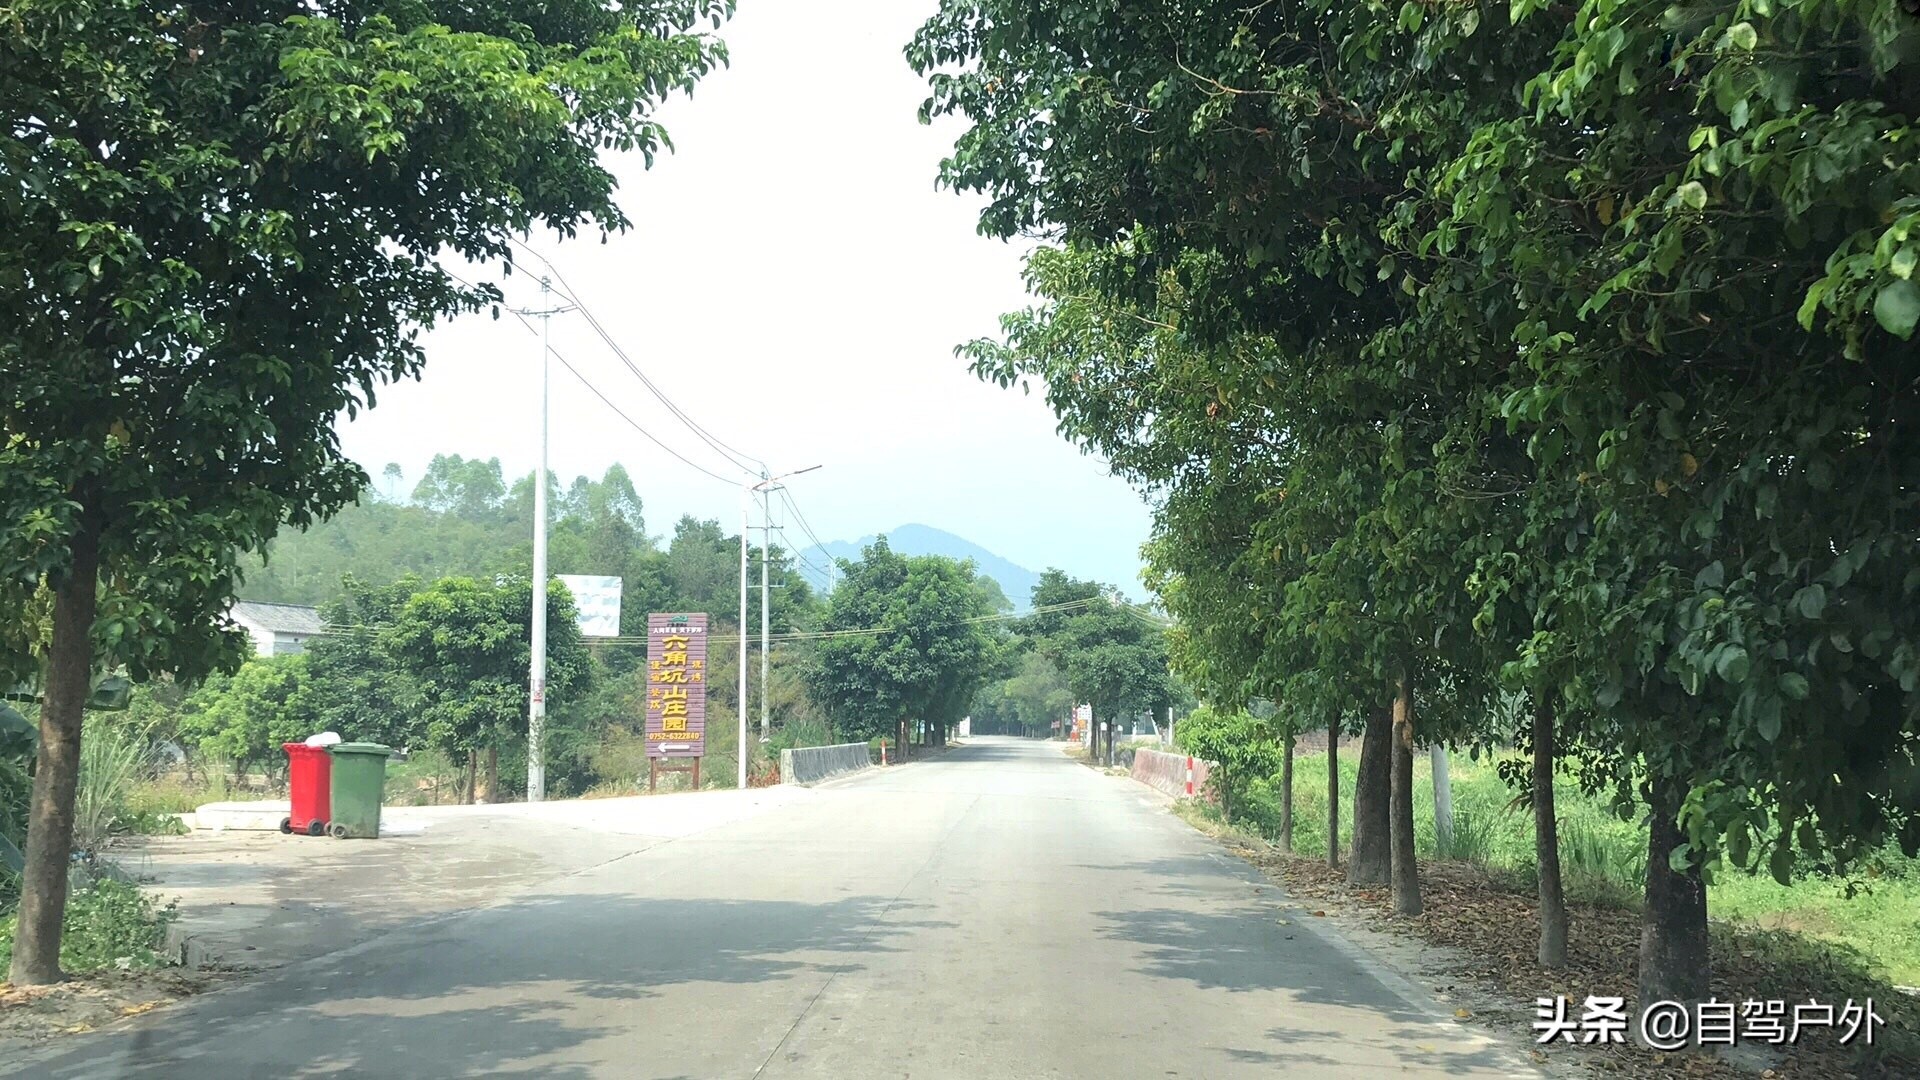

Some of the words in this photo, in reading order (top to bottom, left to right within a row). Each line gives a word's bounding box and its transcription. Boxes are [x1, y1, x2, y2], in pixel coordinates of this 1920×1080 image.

[661, 635, 689, 731] 六角坑山庄园
